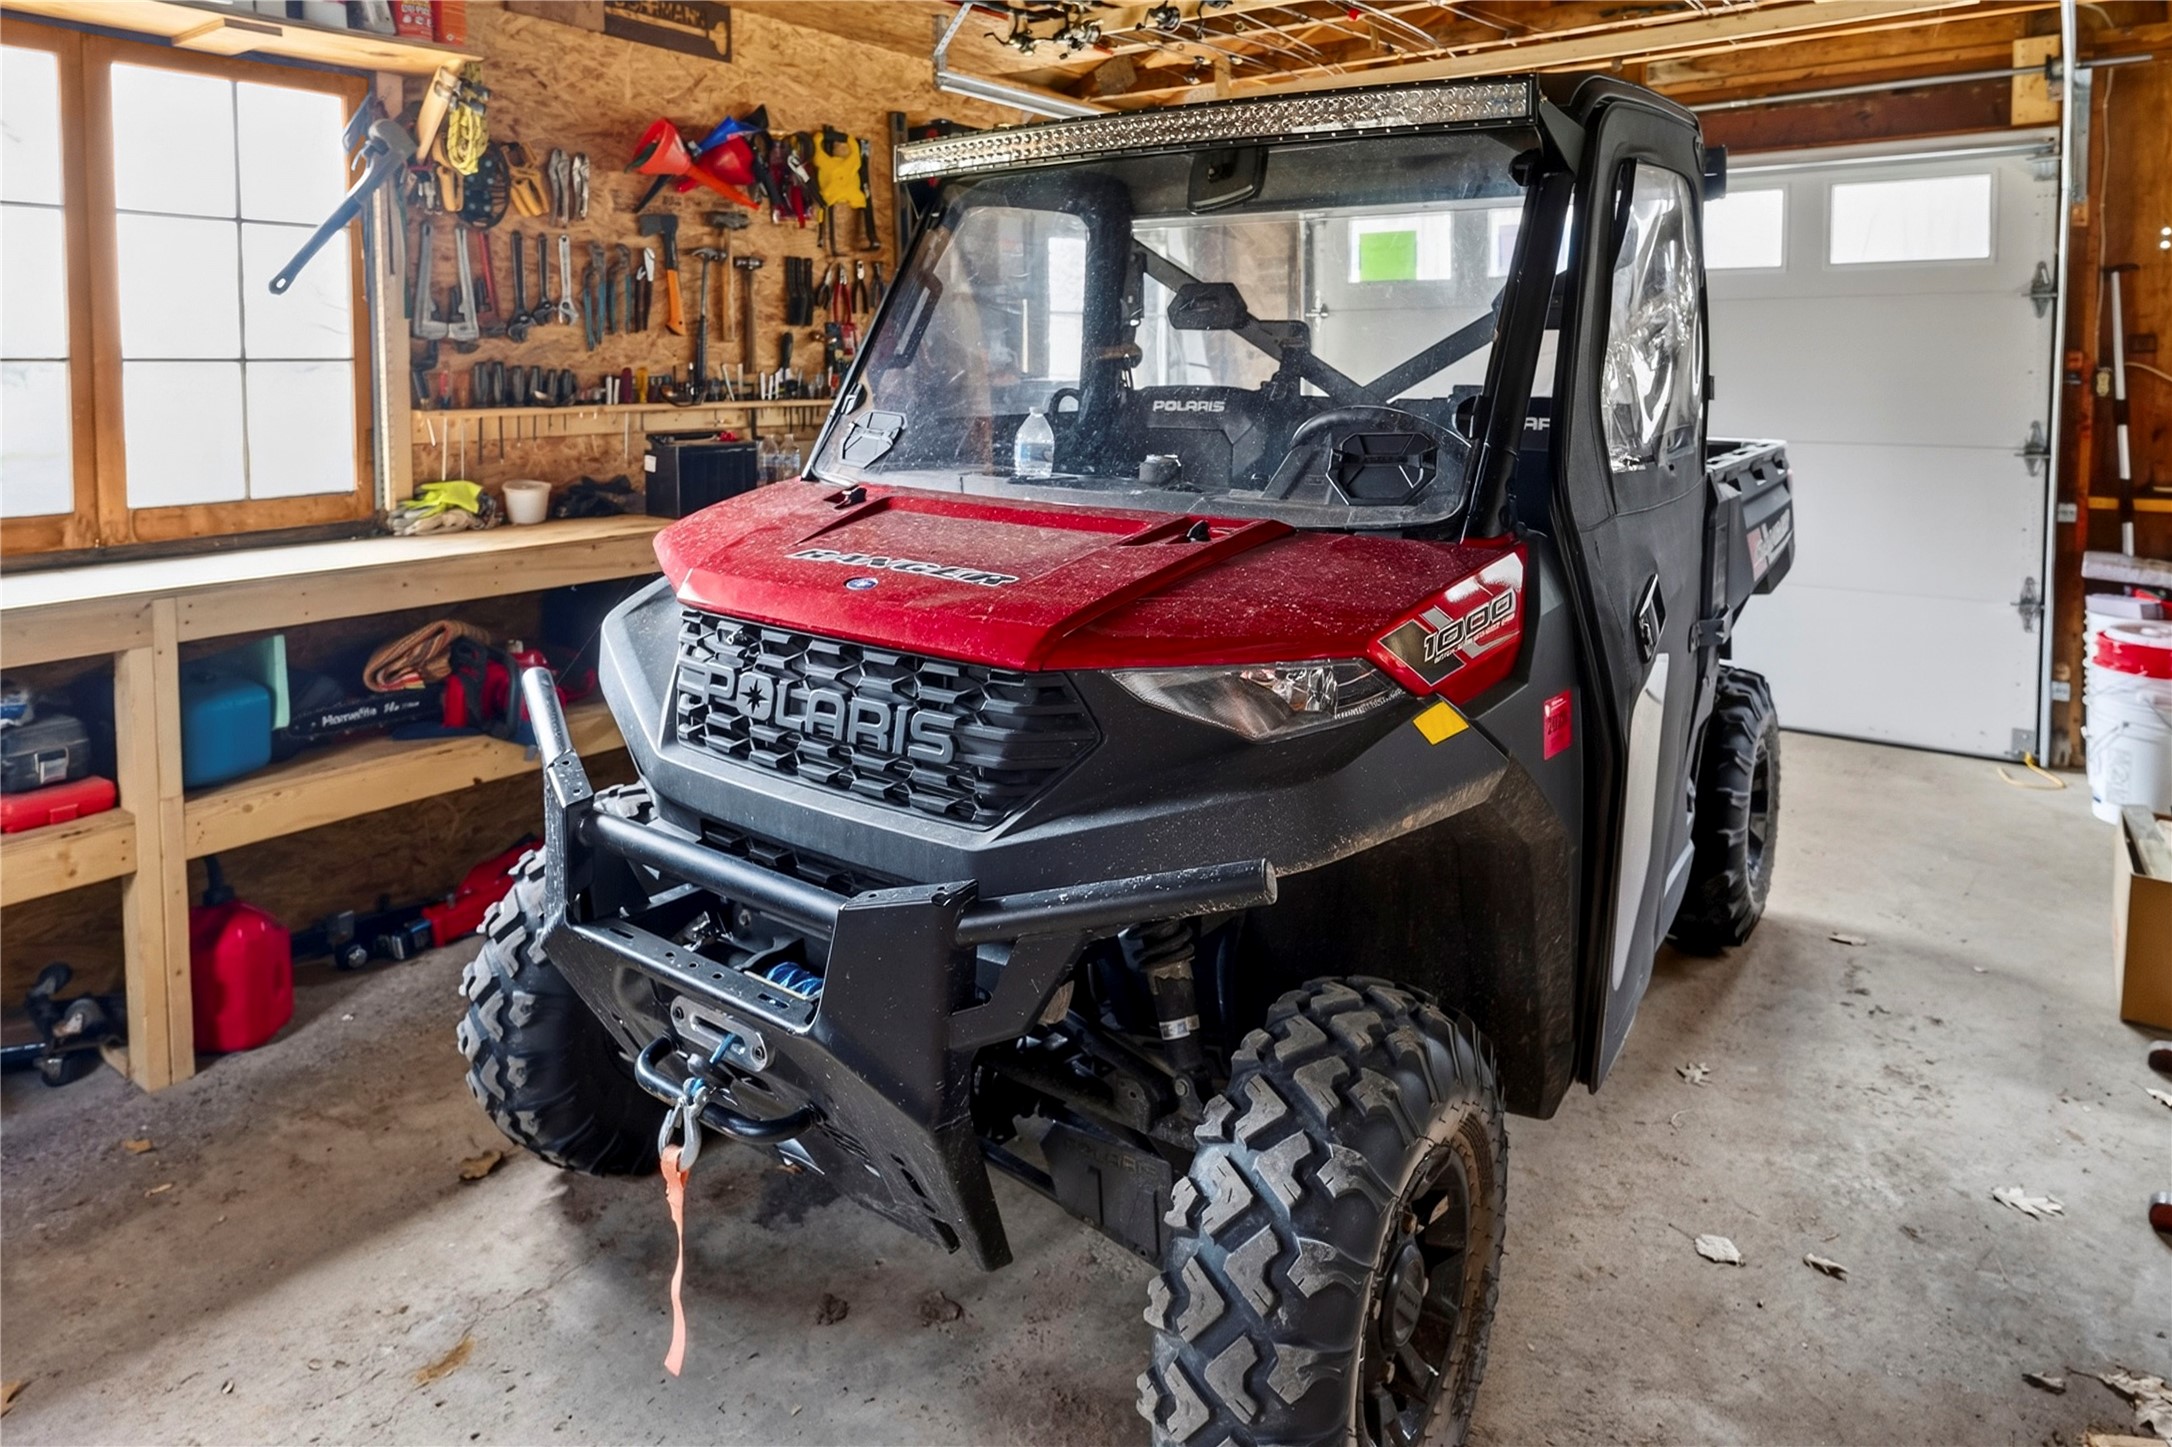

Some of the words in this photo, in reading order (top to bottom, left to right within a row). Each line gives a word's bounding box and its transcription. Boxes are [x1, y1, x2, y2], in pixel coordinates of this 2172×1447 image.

[1152, 400, 1226, 412] POLARIS
[784, 548, 1020, 587] RANGER
[1424, 586, 1516, 662] 1000
[701, 661, 958, 764] POLARIS
